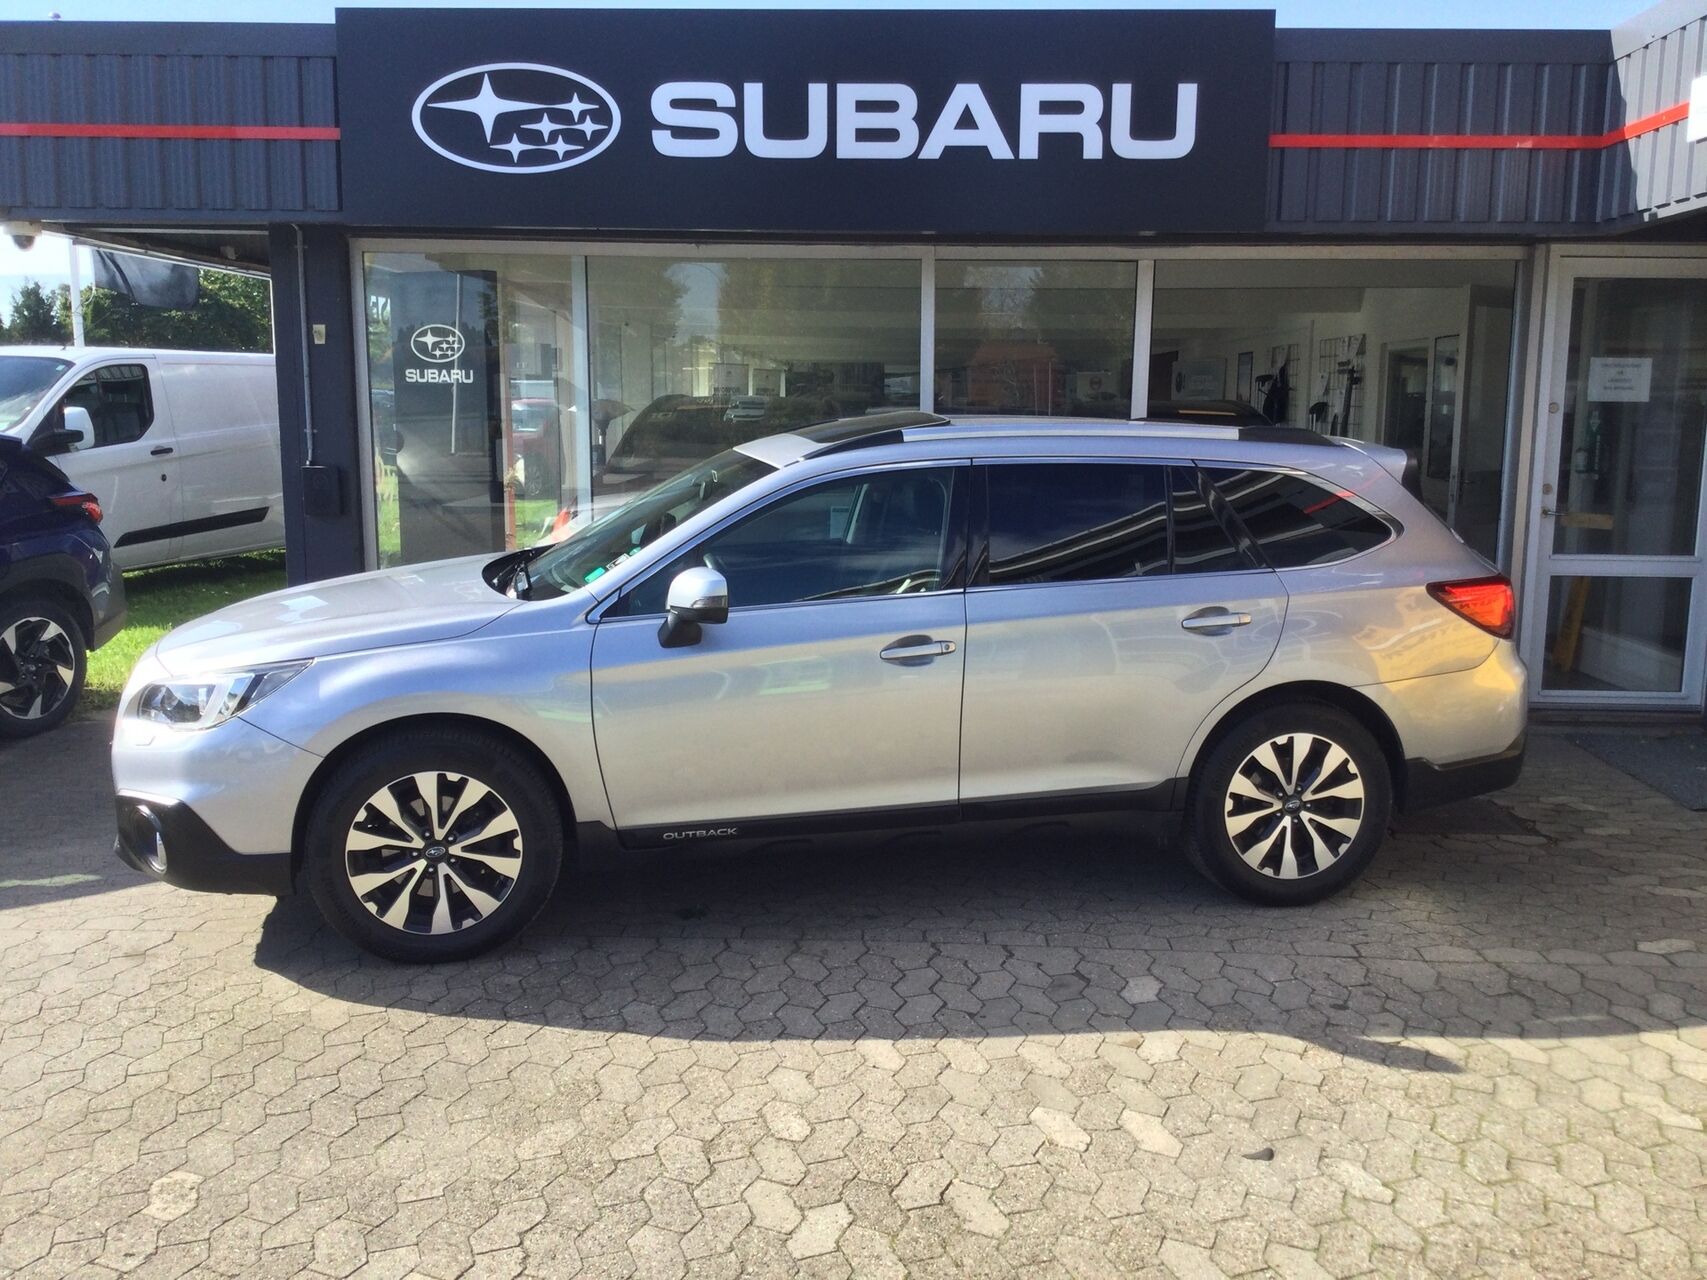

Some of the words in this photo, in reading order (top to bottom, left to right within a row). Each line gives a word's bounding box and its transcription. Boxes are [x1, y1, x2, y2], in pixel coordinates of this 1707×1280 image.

[651, 81, 1198, 160] SUBARU
[405, 368, 474, 383] SUBARU
[662, 827, 738, 840] OUTBACK
